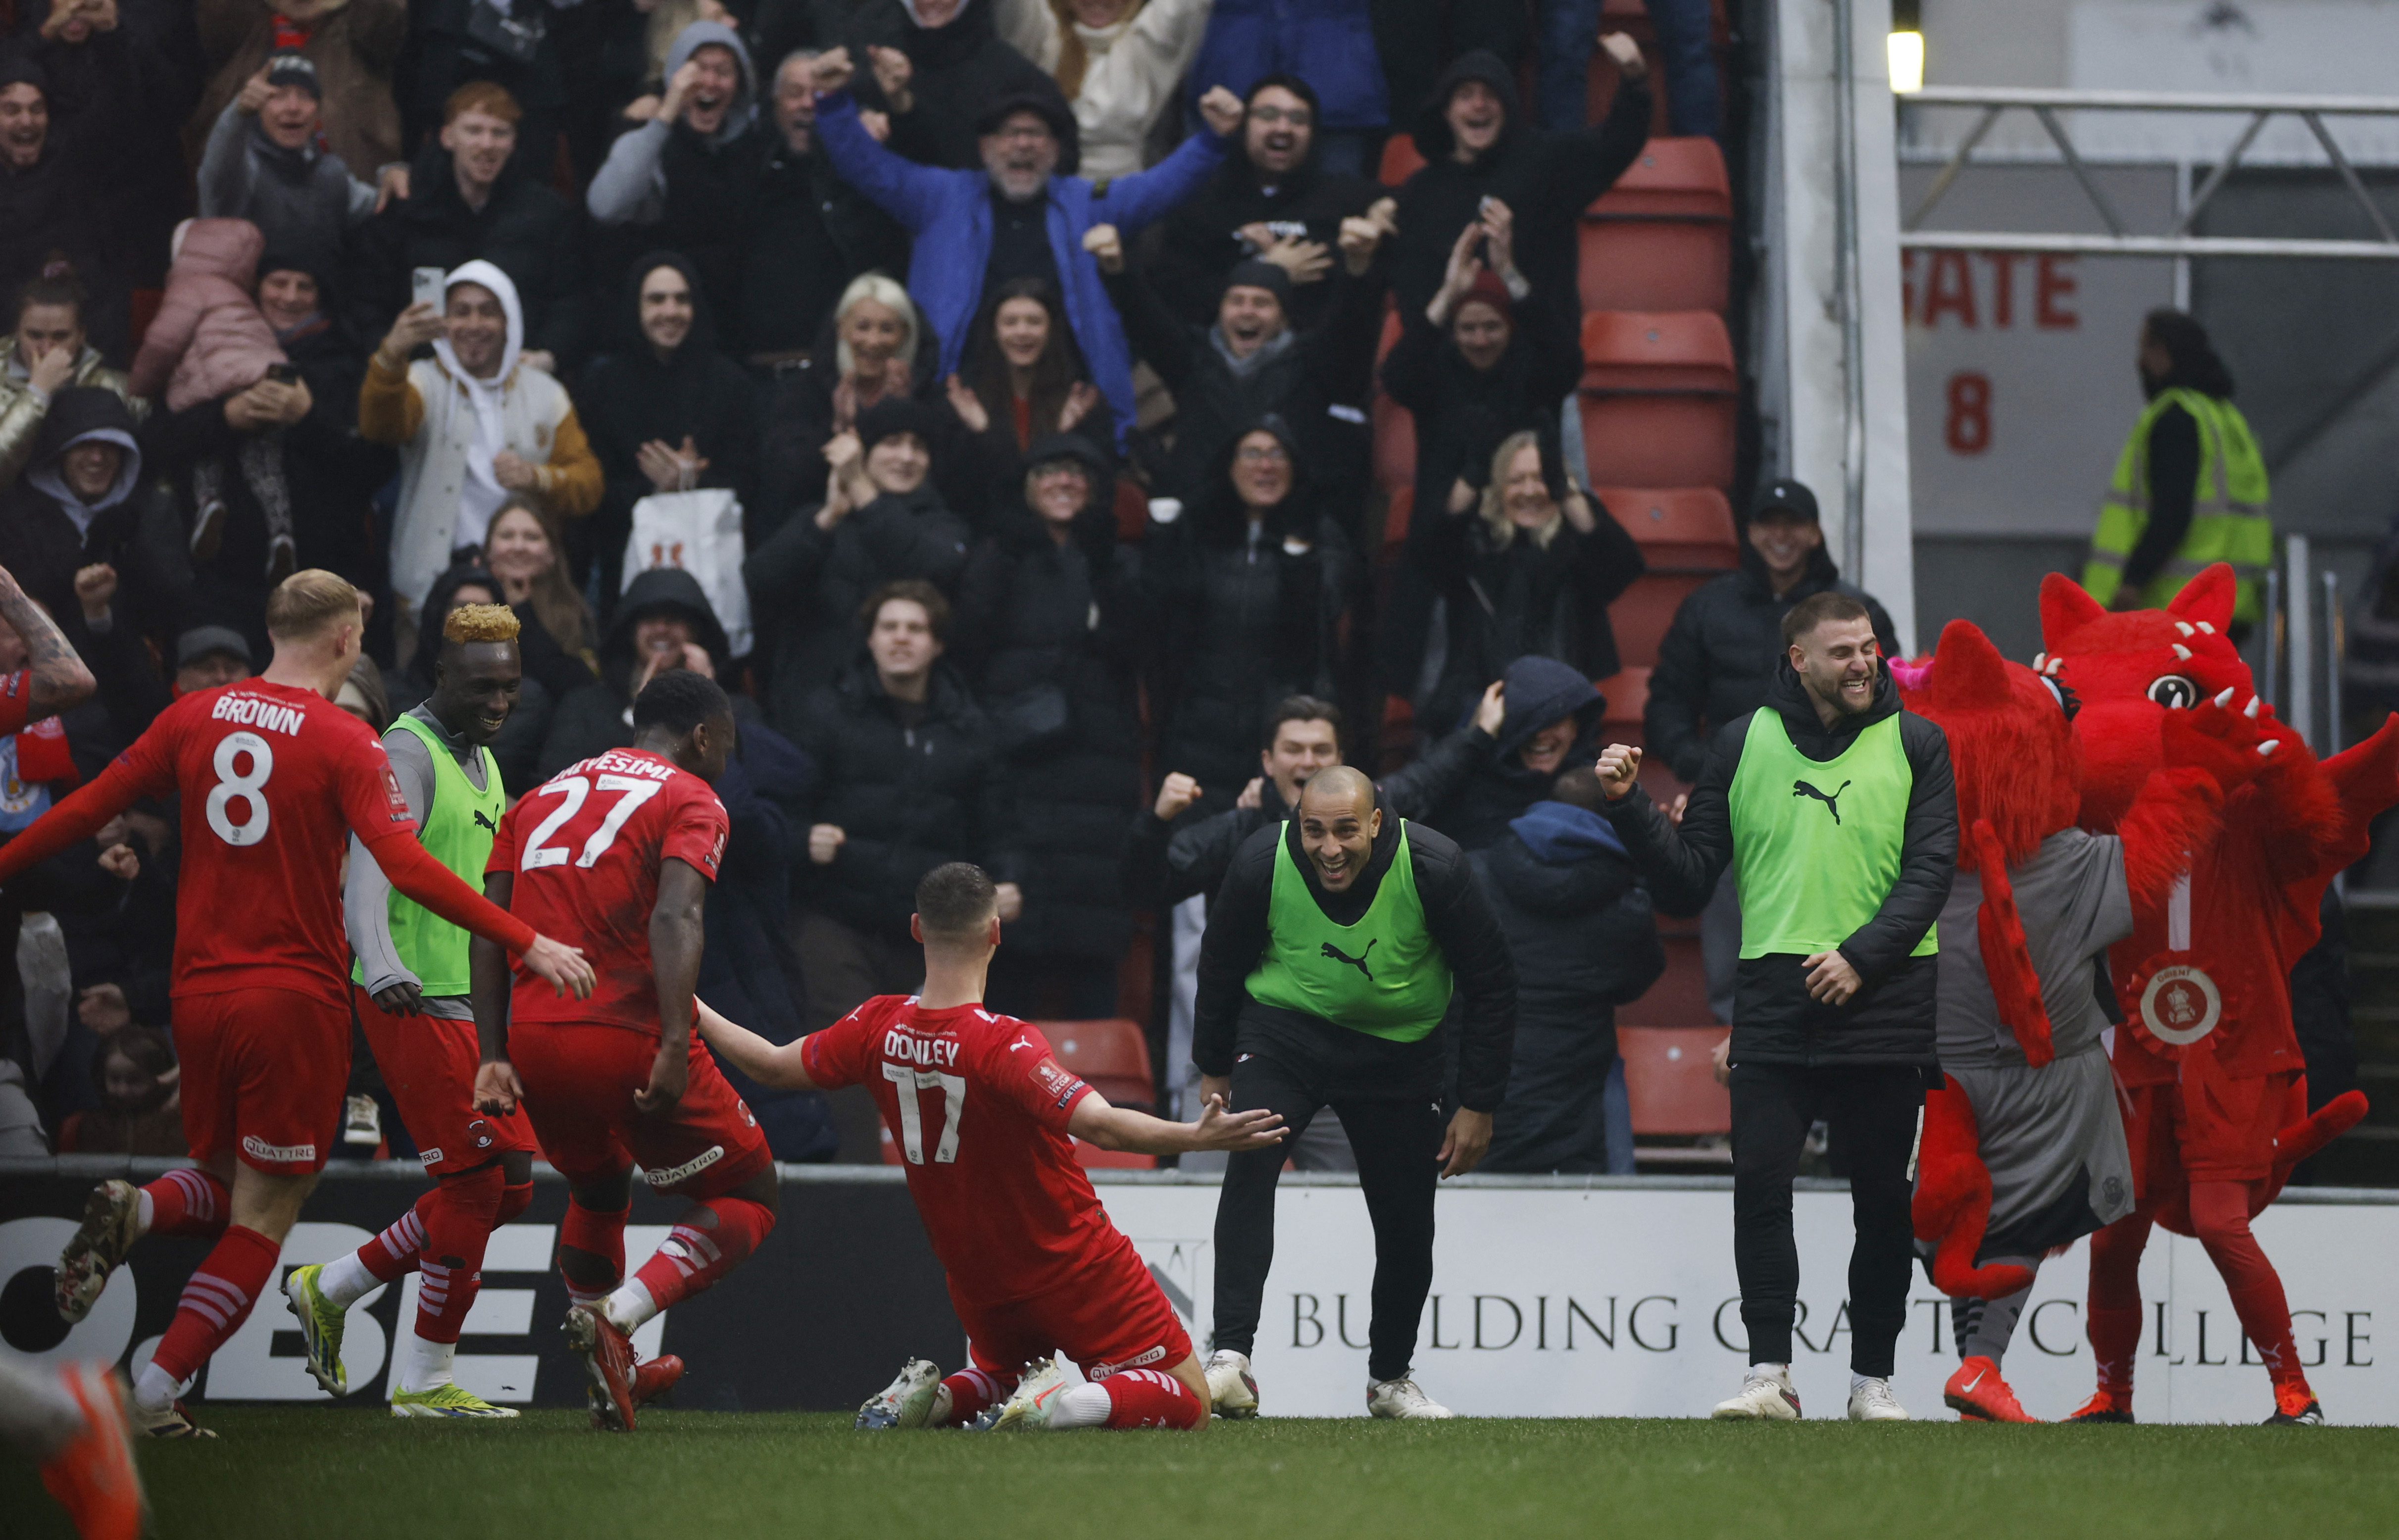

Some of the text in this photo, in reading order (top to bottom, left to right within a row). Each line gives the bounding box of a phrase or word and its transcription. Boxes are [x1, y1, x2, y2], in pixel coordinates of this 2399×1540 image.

[1947, 370, 1991, 455] 8
[211, 695, 305, 737] BROWN
[206, 731, 273, 846] 8
[521, 773, 662, 872] 27
[885, 1030, 959, 1067] DONLEY
[246, 1139, 314, 1158] QUATTRO
[882, 1061, 966, 1166] 17
[648, 1150, 718, 1183] QUATTRO
[1290, 1293, 1681, 1352] BULDING
[2029, 1299, 2373, 1367] CLLGE
